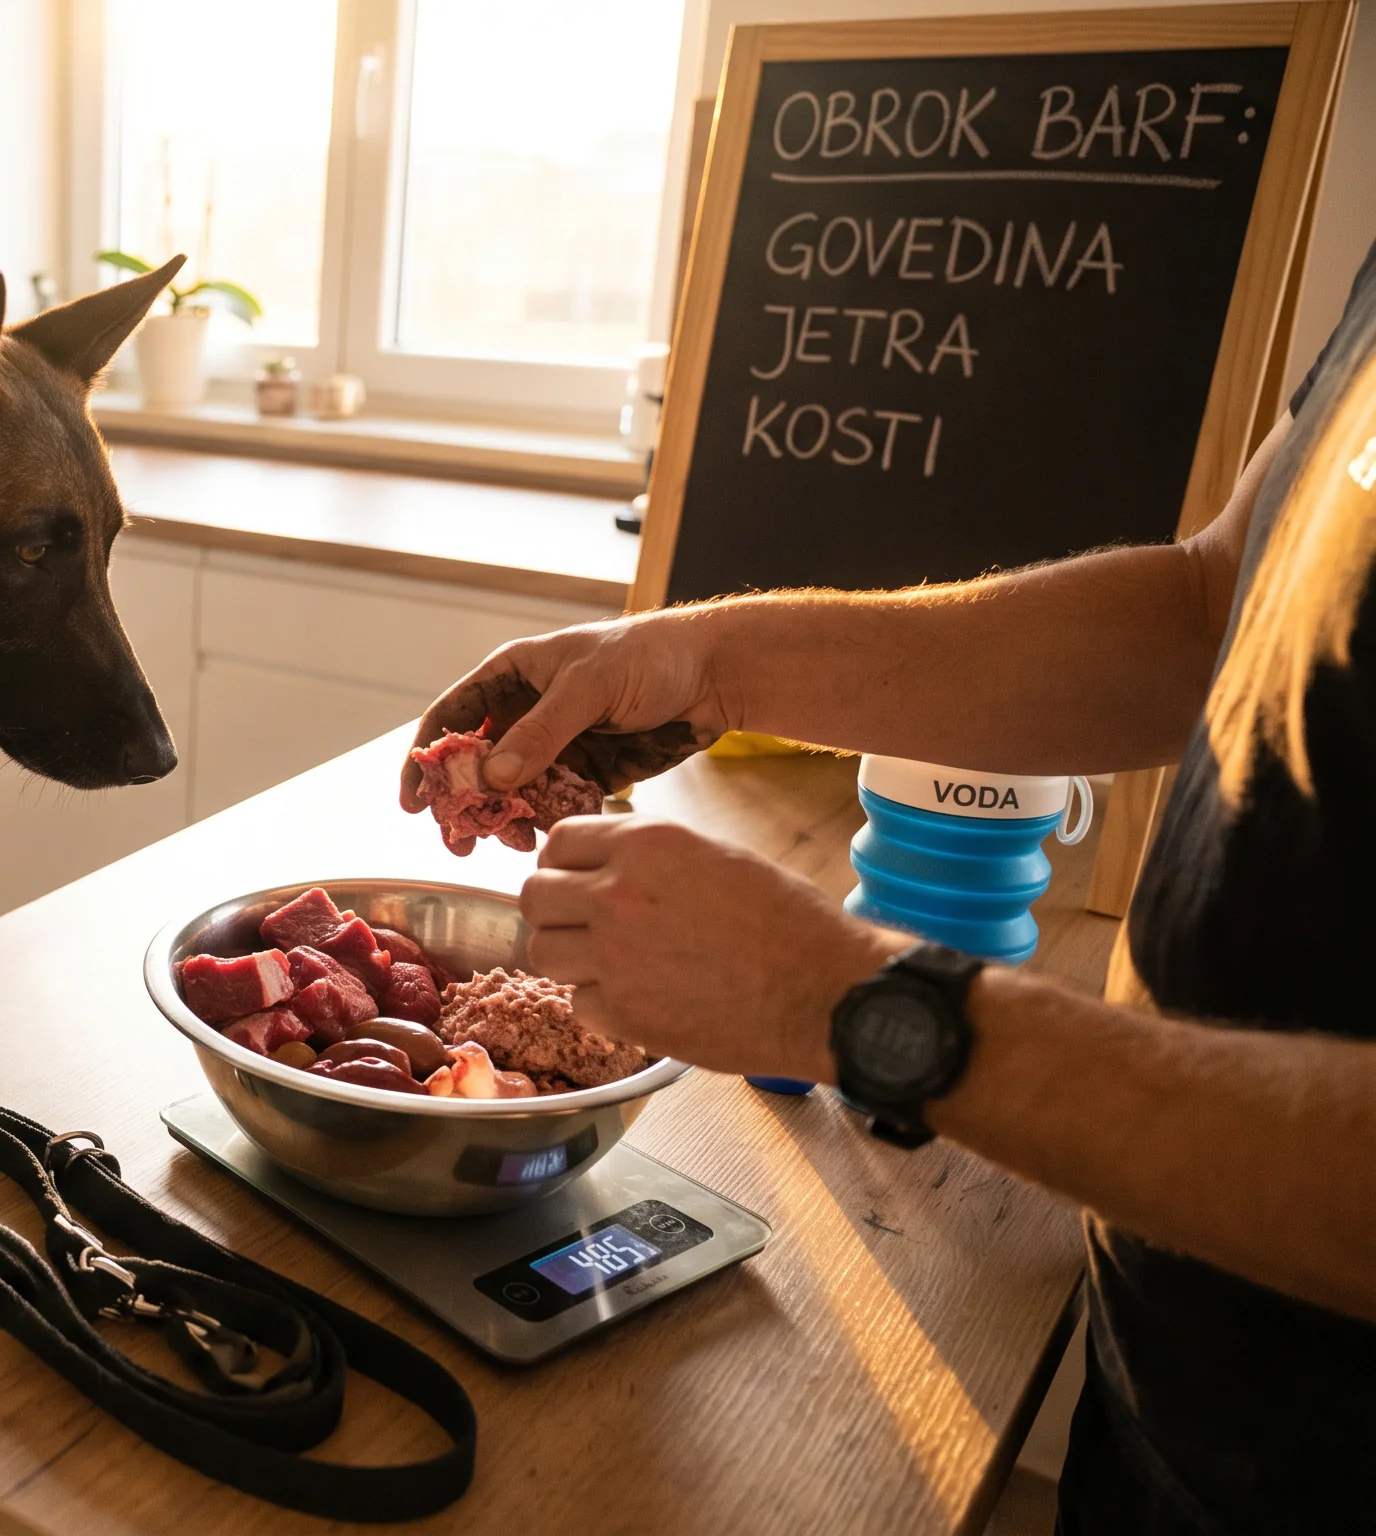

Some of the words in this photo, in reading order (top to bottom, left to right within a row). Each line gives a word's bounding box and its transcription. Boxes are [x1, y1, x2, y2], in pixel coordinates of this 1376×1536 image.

[773, 87, 996, 161] OBROK
[1031, 83, 1256, 161] BARF:
[766, 213, 1123, 294] GOVEDINA
[750, 305, 978, 380] JETRA
[742, 396, 942, 477] KOSTI
[933, 779, 1020, 810] VODA
[568, 1235, 647, 1275] 485
